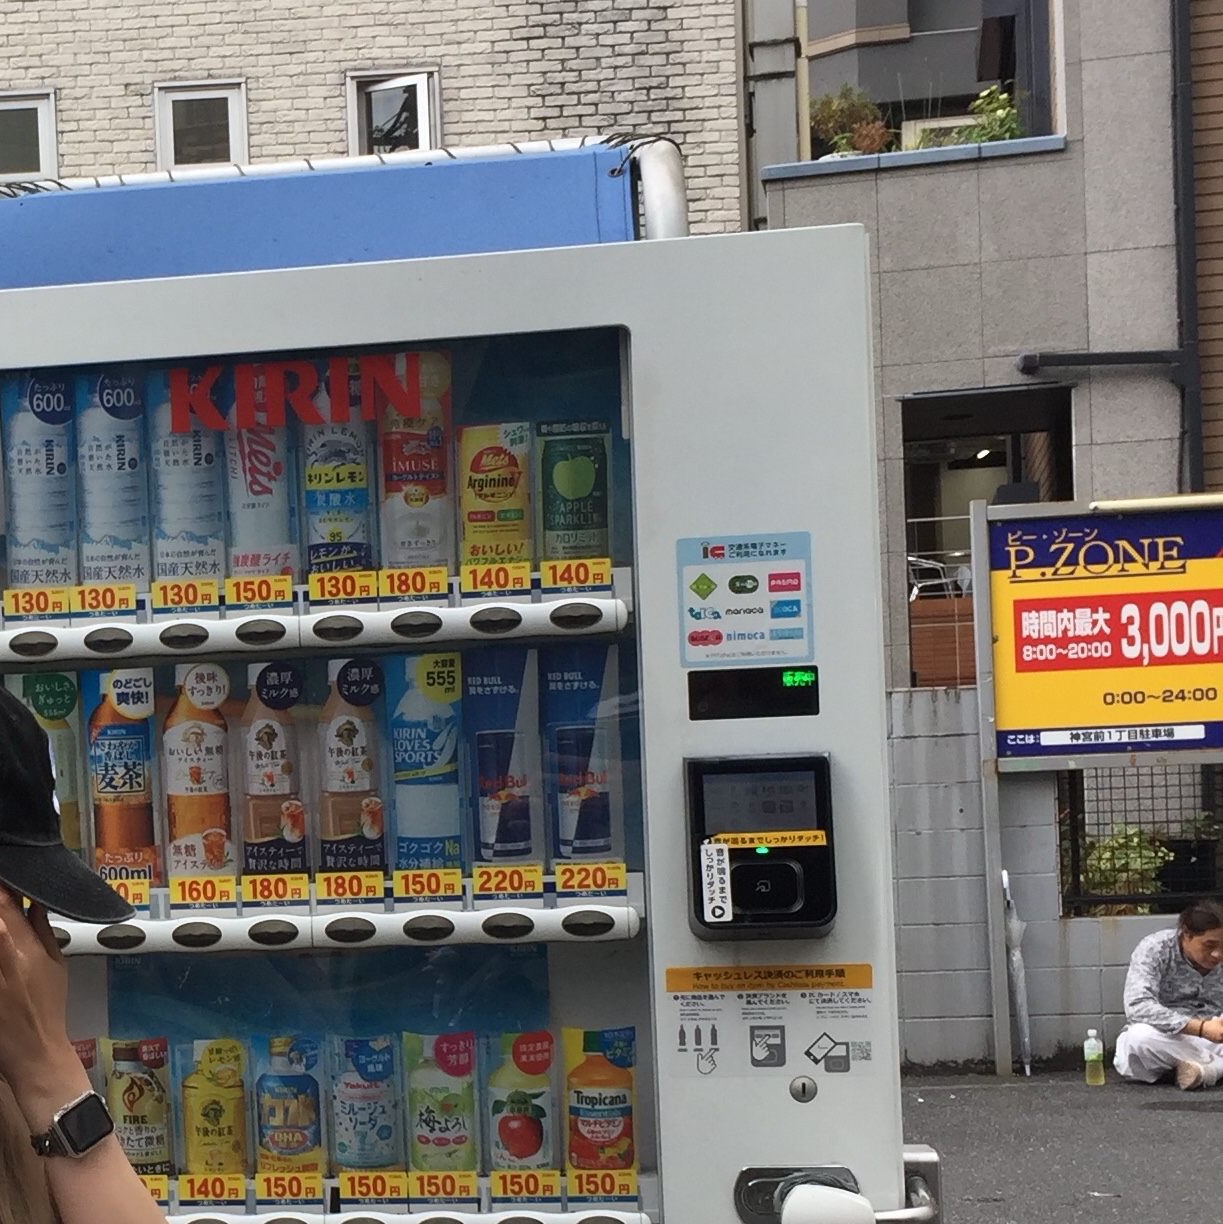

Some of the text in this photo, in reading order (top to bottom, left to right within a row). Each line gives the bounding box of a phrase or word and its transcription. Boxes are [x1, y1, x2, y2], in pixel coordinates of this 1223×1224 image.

[168, 351, 421, 434] KIRIN
[115, 434, 127, 471] KIRIN
[192, 429, 203, 467] KIRIN
[44, 439, 55, 476] KIRIN
[307, 471, 366, 485] キリンレモン
[559, 499, 595, 513] APPLE
[328, 531, 343, 542] 95
[1007, 527, 1099, 546] ピー・ゾーン
[1004, 536, 1189, 580] P.ZONE
[9, 568, 73, 584] 国産天然水
[83, 563, 146, 581] 国産天然水
[157, 560, 221, 577] 国産天然水
[1021, 606, 1112, 640] 時間内最大
[726, 630, 766, 641] nimoca
[194, 671, 218, 684] 後味
[265, 671, 293, 685] 濃厚
[346, 667, 374, 681] 濃厚
[425, 669, 457, 687] 555
[112, 677, 153, 690] のどごし
[261, 686, 299, 700] ミルク感
[1069, 727, 1175, 743] 神宮前1丁目駐車場
[97, 761, 144, 792] 麦茶
[398, 841, 444, 855] ゴクゴク
[104, 851, 144, 864] たっぷり
[98, 864, 153, 880] 600ml
[573, 1090, 628, 1108] Tropicana
[122, 1114, 148, 1125] FIRE
